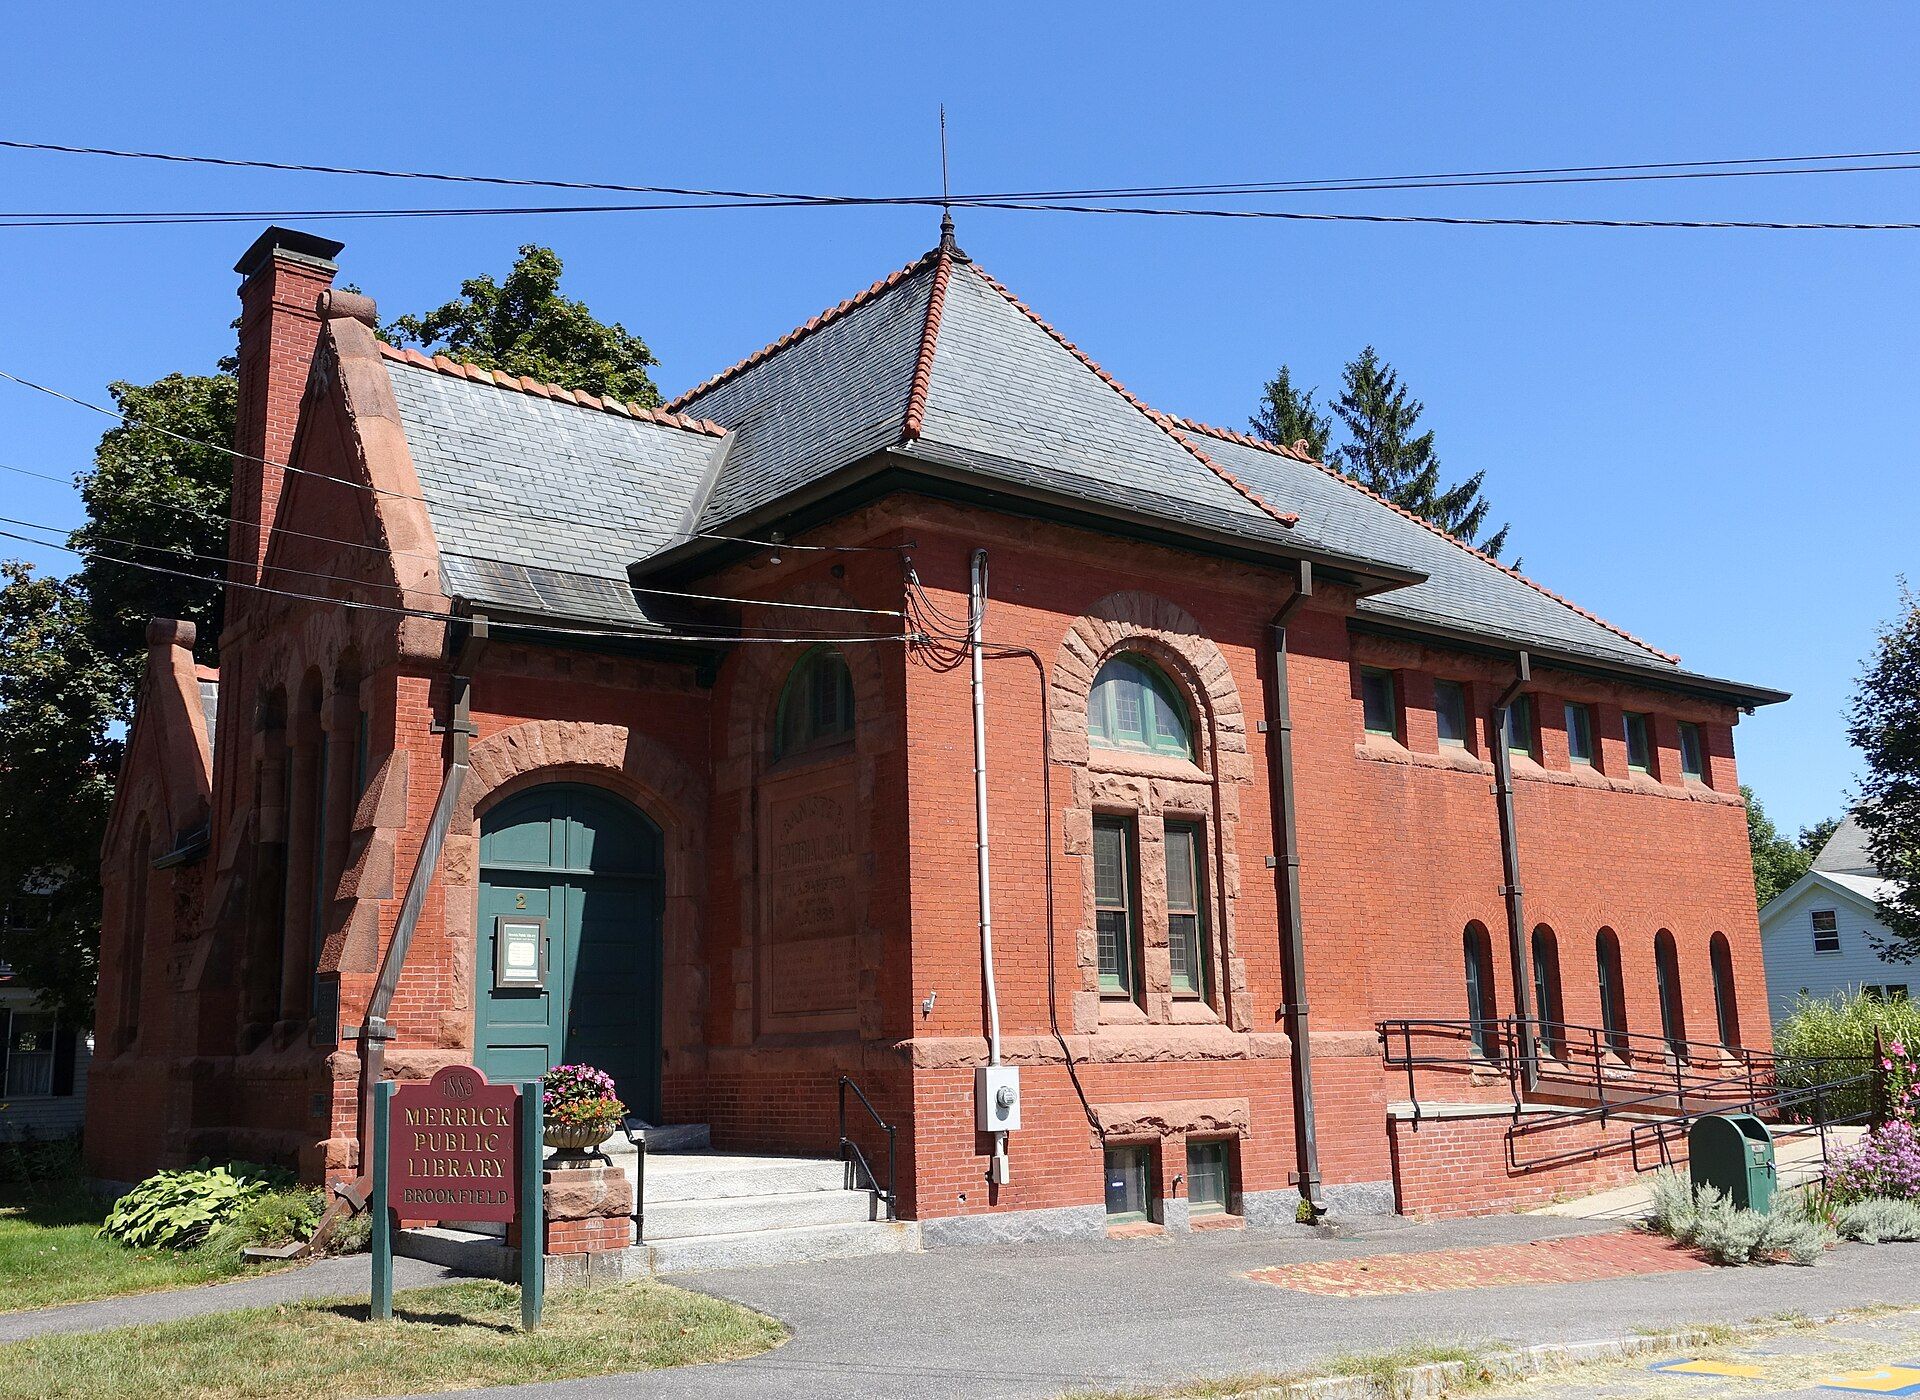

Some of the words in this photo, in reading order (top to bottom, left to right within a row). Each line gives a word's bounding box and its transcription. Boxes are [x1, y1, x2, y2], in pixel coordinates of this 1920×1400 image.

[516, 893, 527, 909] 2
[405, 1108, 510, 1127] MERRICK
[414, 1132, 500, 1152] PUBLIC
[408, 1158, 506, 1178] LIBRARY
[404, 1188, 508, 1206] BROOKFIELD
